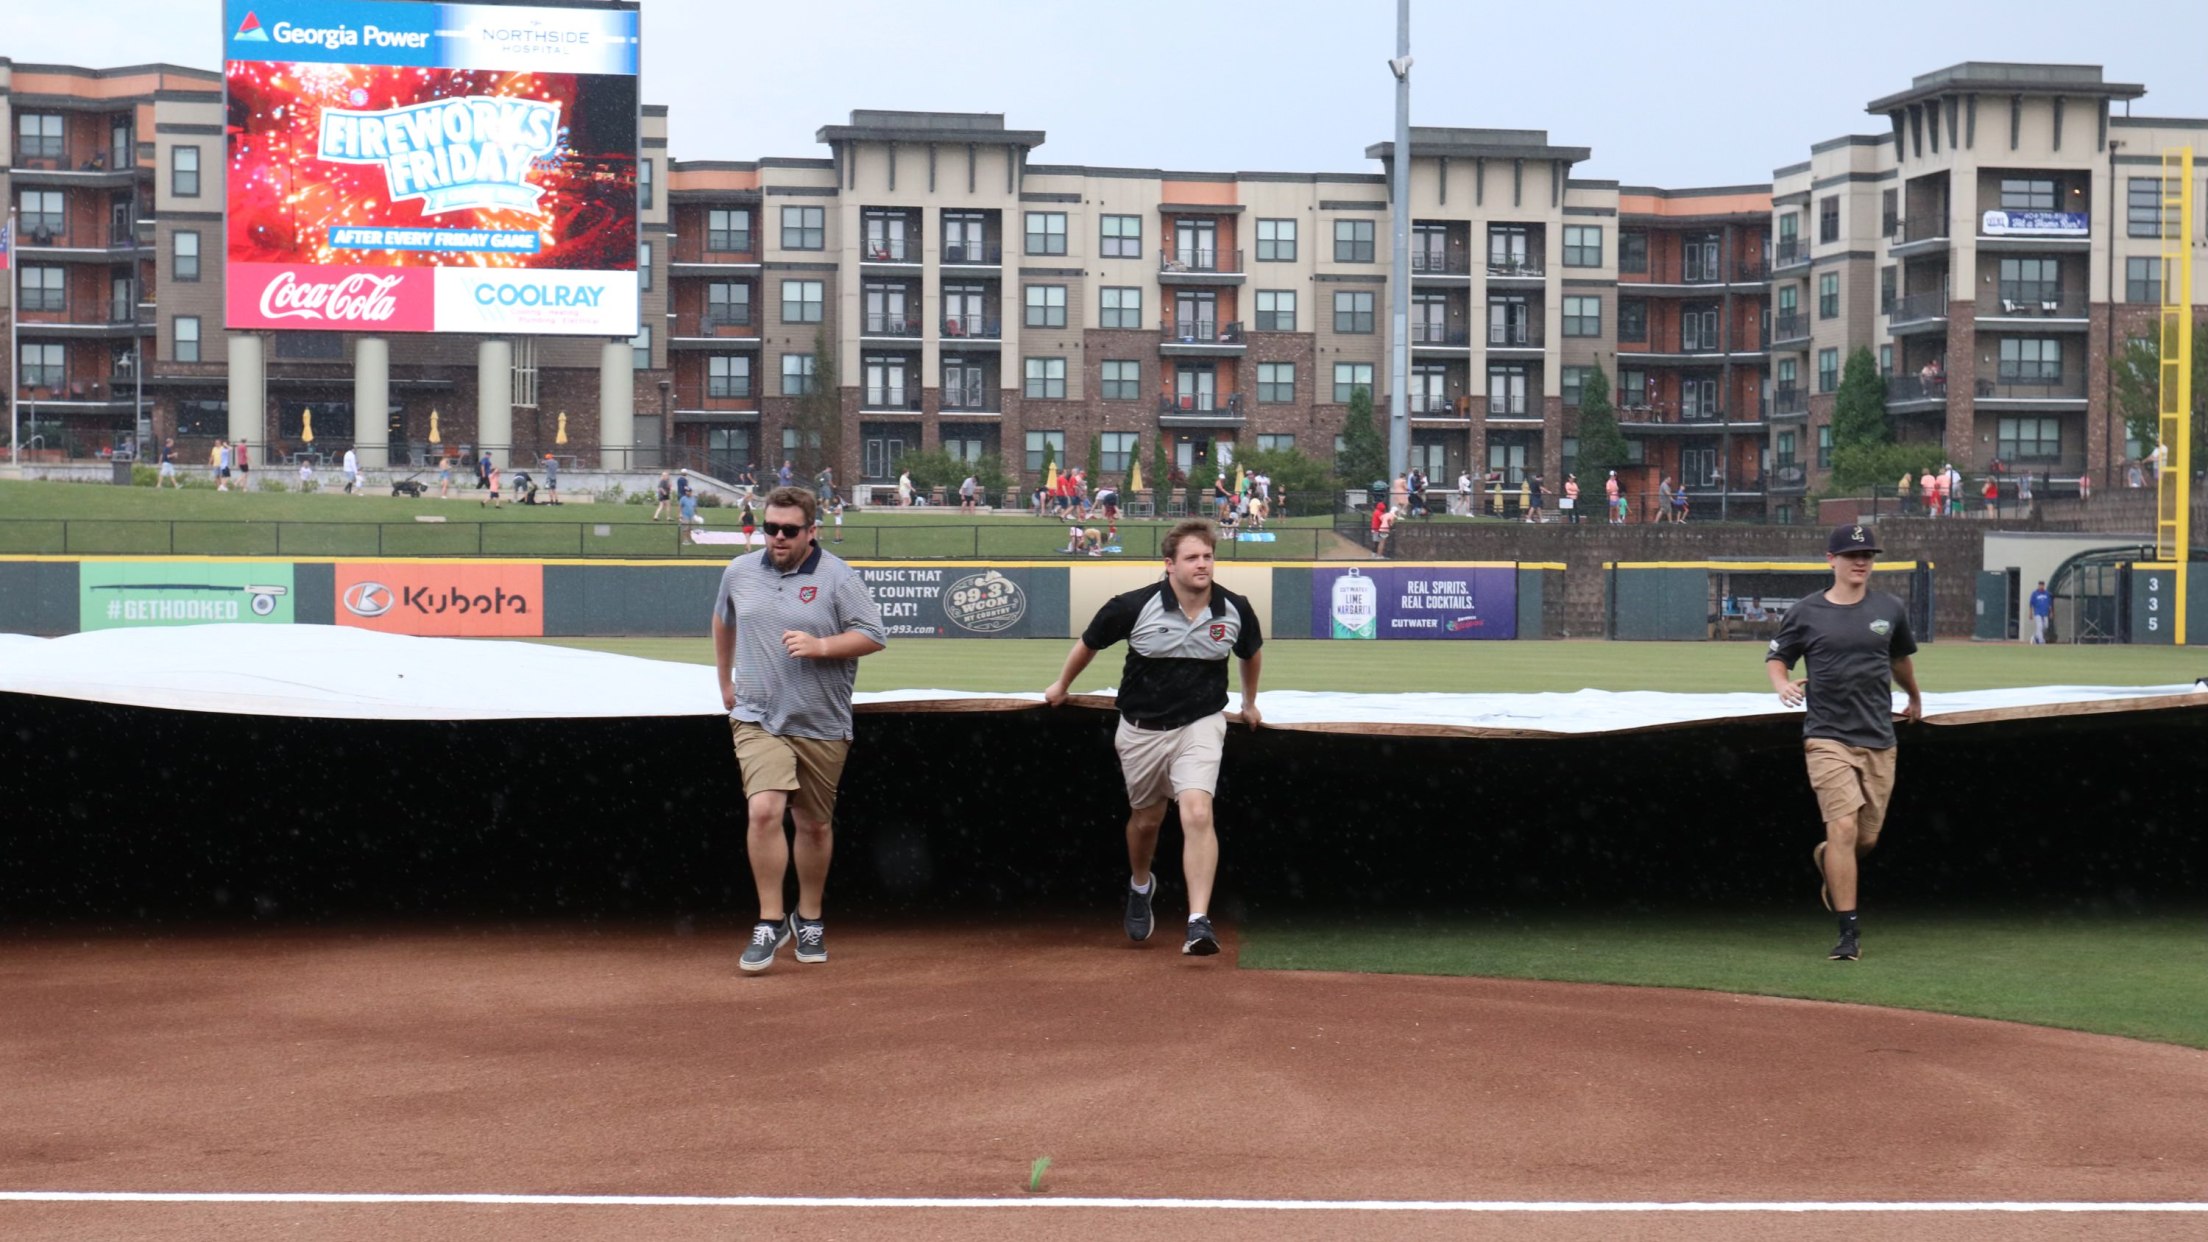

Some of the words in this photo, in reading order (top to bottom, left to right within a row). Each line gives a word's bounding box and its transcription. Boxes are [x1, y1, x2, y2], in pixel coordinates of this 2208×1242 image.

[273, 21, 357, 49] Georgia
[364, 25, 430, 48] Power
[482, 29, 589, 44] NORTHSIDE
[502, 45, 570, 54] HOSPITAL
[324, 102, 552, 158] FIREWORKS
[389, 142, 531, 194] FRIDAY
[334, 230, 383, 245] AFTER
[384, 231, 434, 246] EVERY
[434, 233, 489, 247] FRIDAY
[490, 234, 535, 249] GAME
[259, 271, 404, 321] Coca-Cola
[475, 283, 605, 307] COOLRAY
[864, 570, 905, 582] MUSIC
[908, 570, 942, 582] THAT
[879, 586, 940, 598] COUNTRY
[1407, 580, 1429, 594] REAL
[1432, 581, 1469, 595] SPIRITS.
[403, 586, 527, 614] Kubota
[961, 595, 1009, 613] WCON
[1401, 595, 1423, 609] REAL
[1426, 595, 1475, 609] COCKTAILS.
[107, 599, 239, 620] #GETHOOKED
[1391, 619, 1438, 628] CUTWATER
